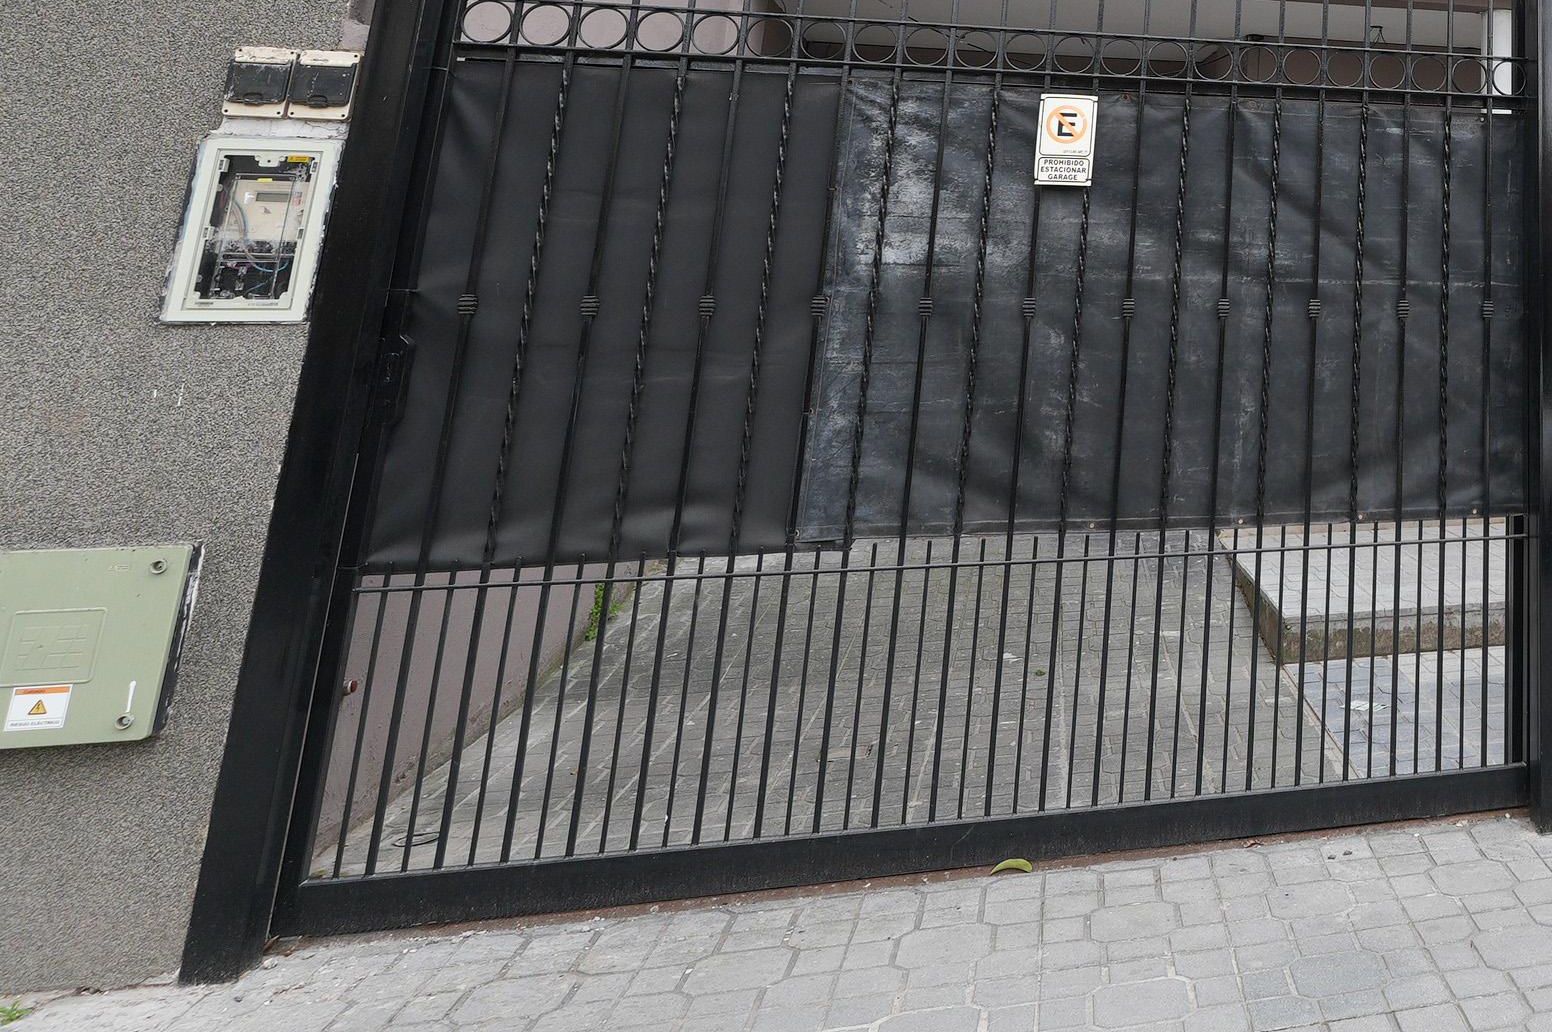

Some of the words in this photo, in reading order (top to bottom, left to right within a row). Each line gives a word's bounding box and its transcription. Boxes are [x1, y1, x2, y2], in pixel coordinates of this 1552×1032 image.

[1043, 159, 1084, 167] PROHIBIDO
[1040, 166, 1086, 174] ESTACIONAR
[1047, 173, 1078, 181] GARAGE
